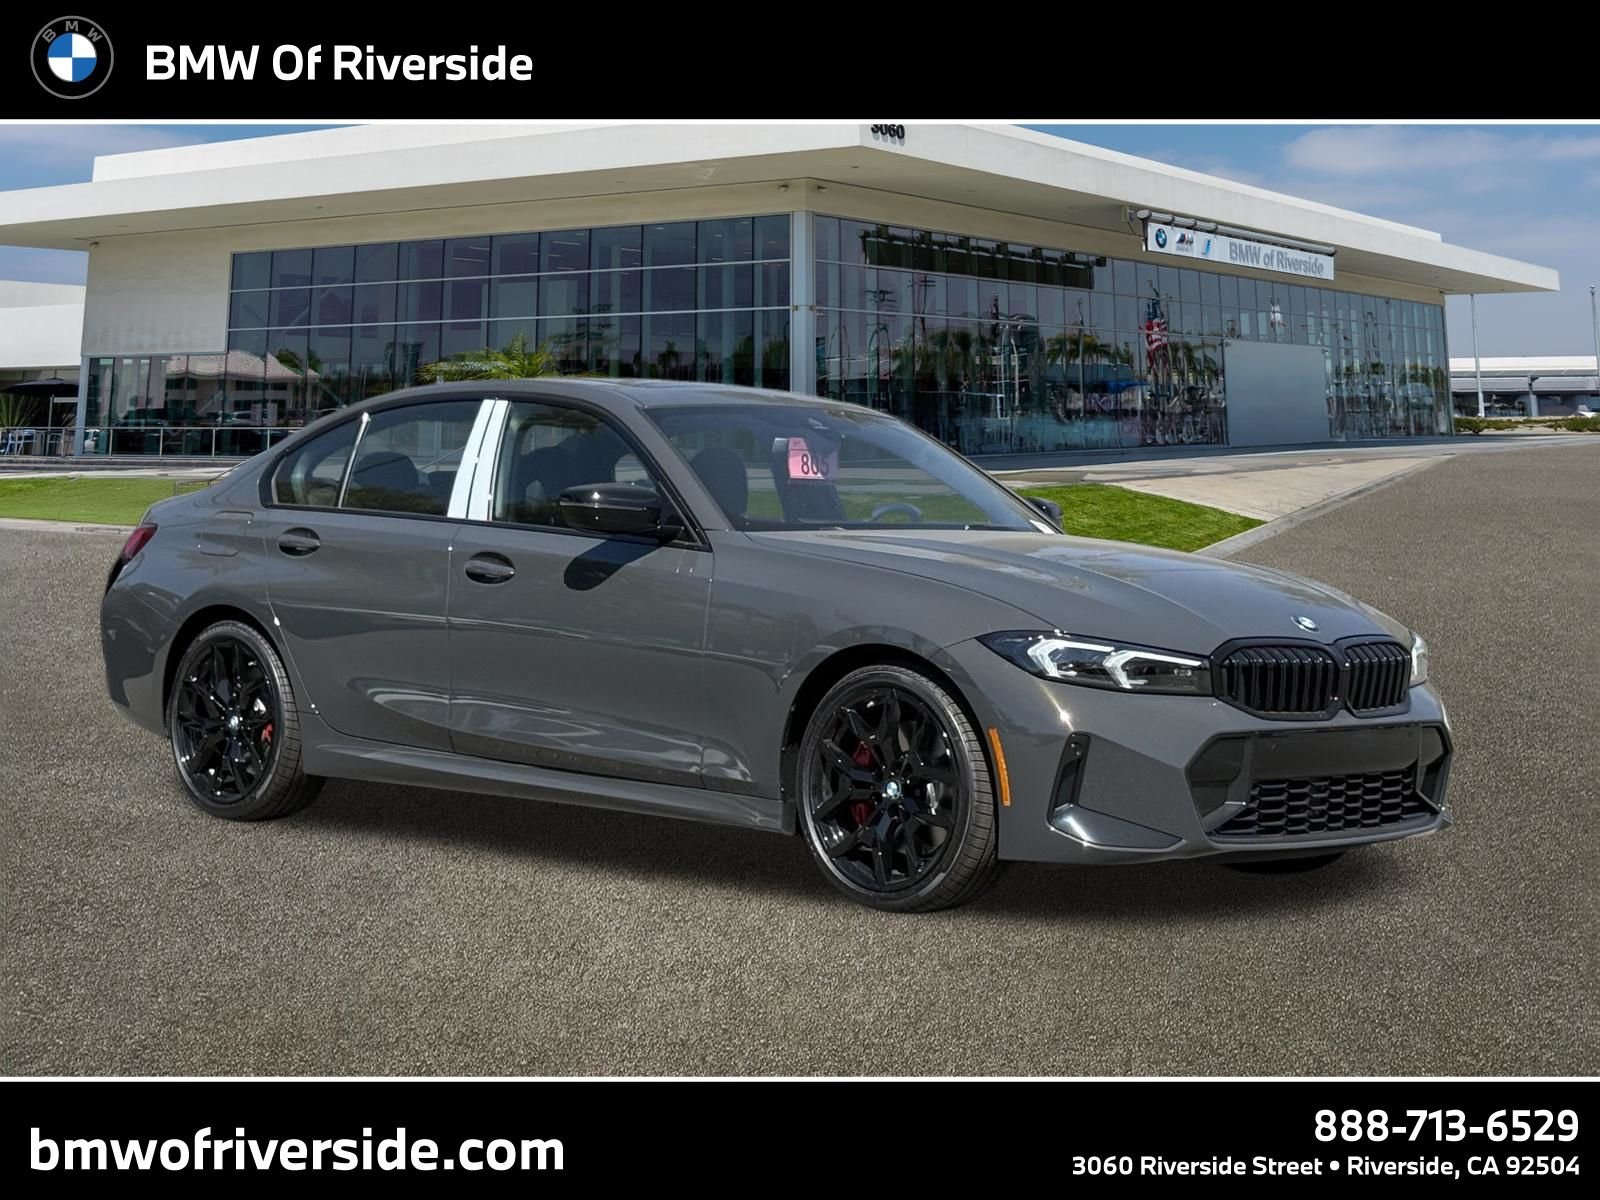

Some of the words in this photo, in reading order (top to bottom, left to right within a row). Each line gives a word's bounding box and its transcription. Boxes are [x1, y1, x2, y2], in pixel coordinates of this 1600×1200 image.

[1229, 241, 1261, 265] BMW
[1262, 249, 1275, 268] of
[1276, 250, 1324, 275] Riverside
